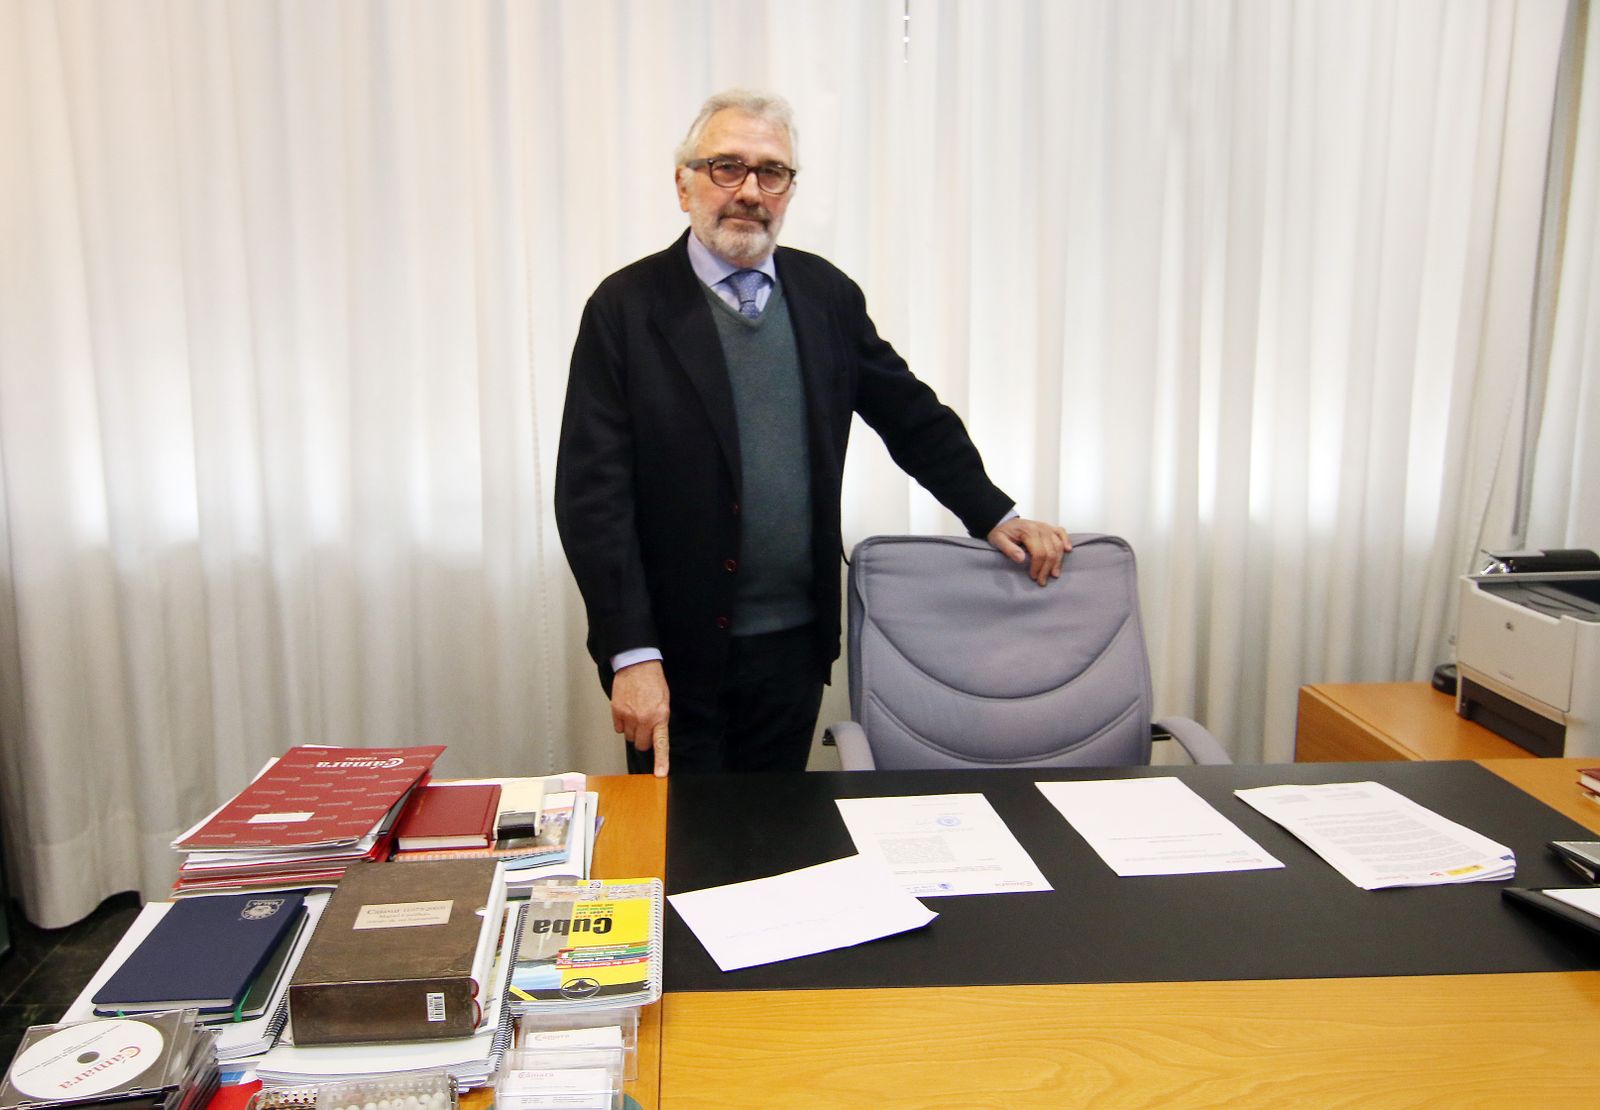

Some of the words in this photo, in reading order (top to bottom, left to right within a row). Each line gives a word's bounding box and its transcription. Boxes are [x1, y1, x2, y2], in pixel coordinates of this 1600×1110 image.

[316, 758, 404, 769] Cámara
[533, 918, 612, 935] Cuba
[58, 1046, 141, 1089] Cámara
